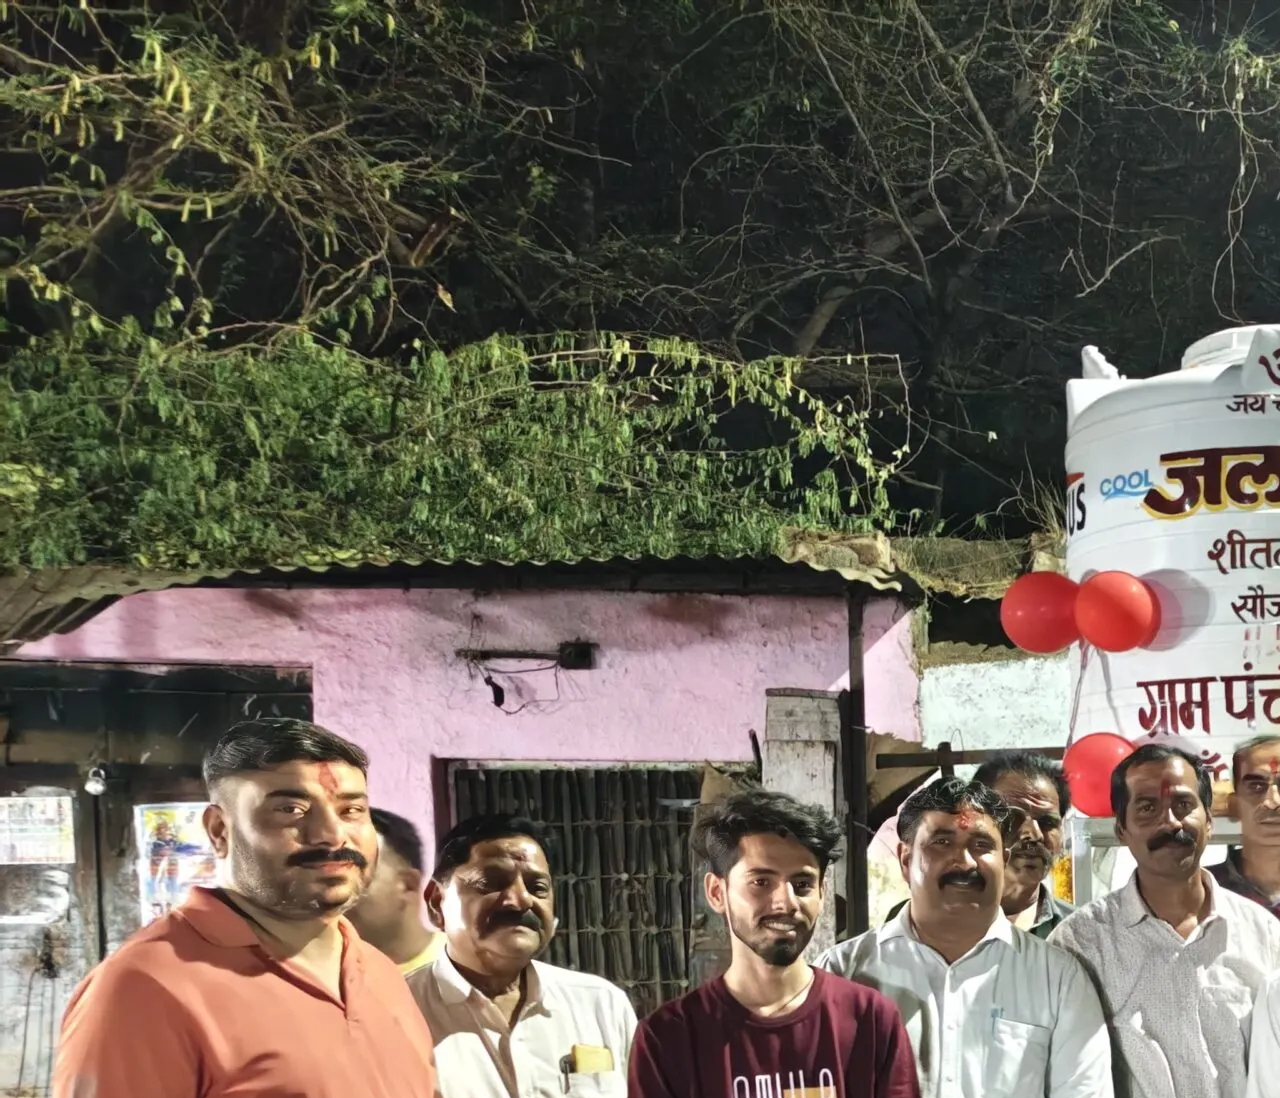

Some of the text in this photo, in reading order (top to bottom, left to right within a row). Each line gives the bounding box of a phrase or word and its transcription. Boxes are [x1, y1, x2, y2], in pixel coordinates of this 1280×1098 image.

[1226, 394, 1266, 414] जय
[1100, 469, 1153, 496] COOL
[1136, 675, 1218, 737] ग्राम
